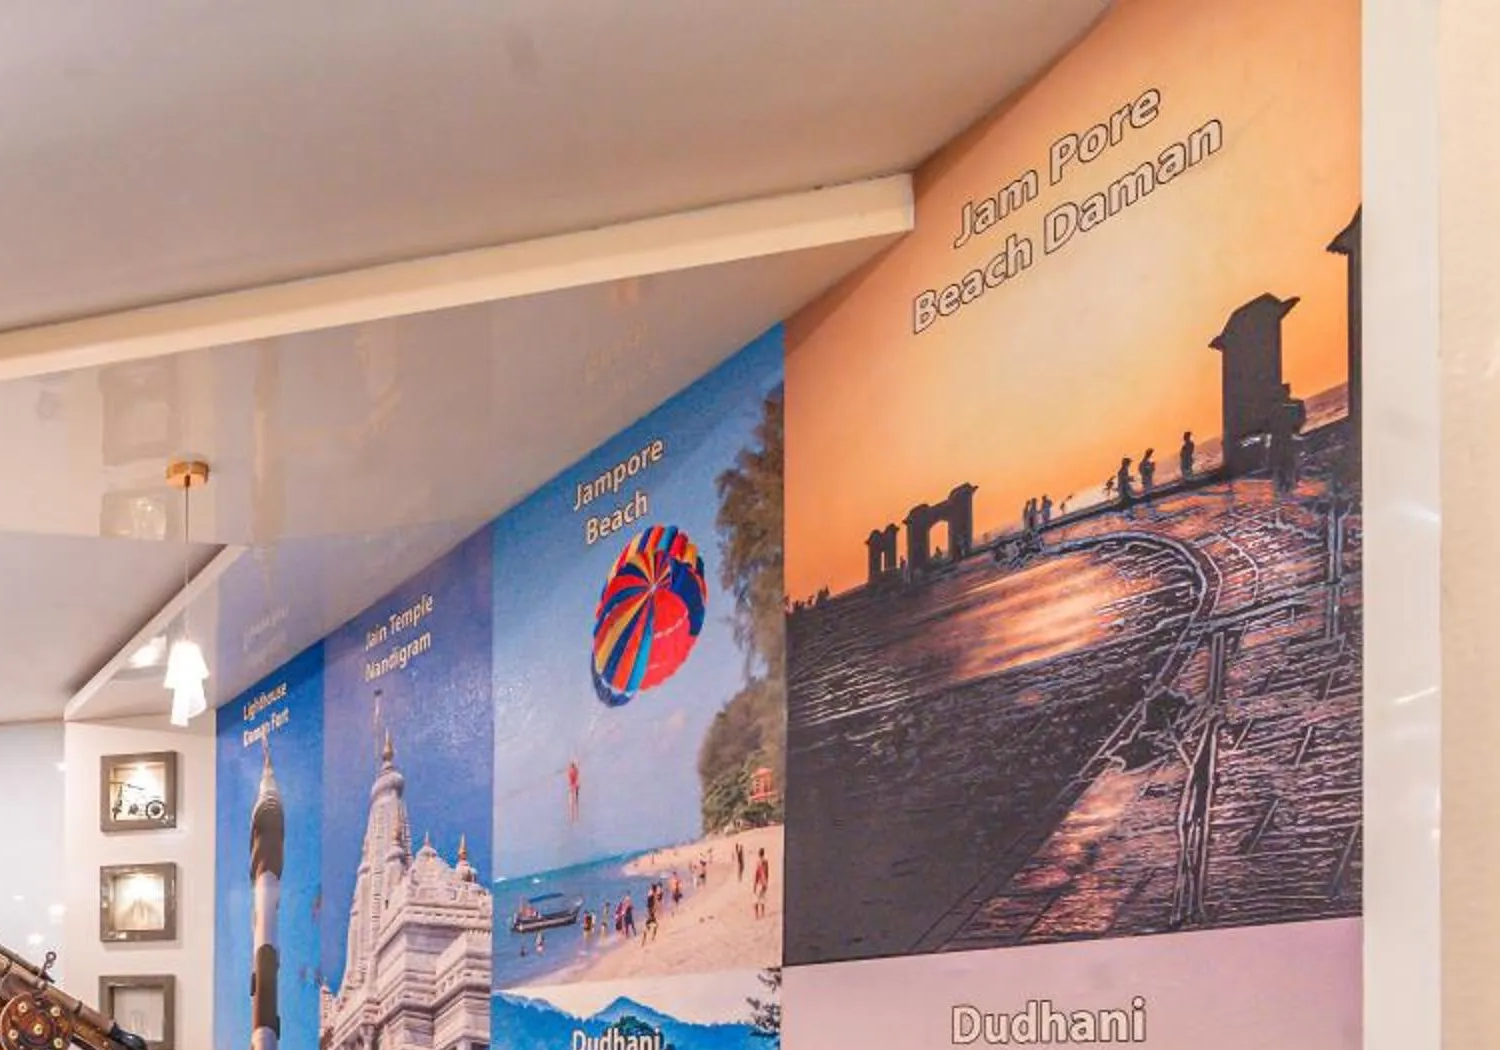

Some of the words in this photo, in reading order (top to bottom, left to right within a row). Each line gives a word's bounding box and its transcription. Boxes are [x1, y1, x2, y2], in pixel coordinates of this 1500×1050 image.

[953, 168, 1039, 250] Jam
[1050, 87, 1161, 187] Pore
[913, 233, 1034, 335] Beach
[1043, 118, 1223, 255] Daman
[573, 439, 666, 512] Jampore
[586, 490, 648, 545] Beach
[365, 623, 387, 651] Jain
[389, 594, 434, 635] Temple
[365, 631, 432, 682] Nandigram
[951, 996, 1147, 1045] Dudhani
